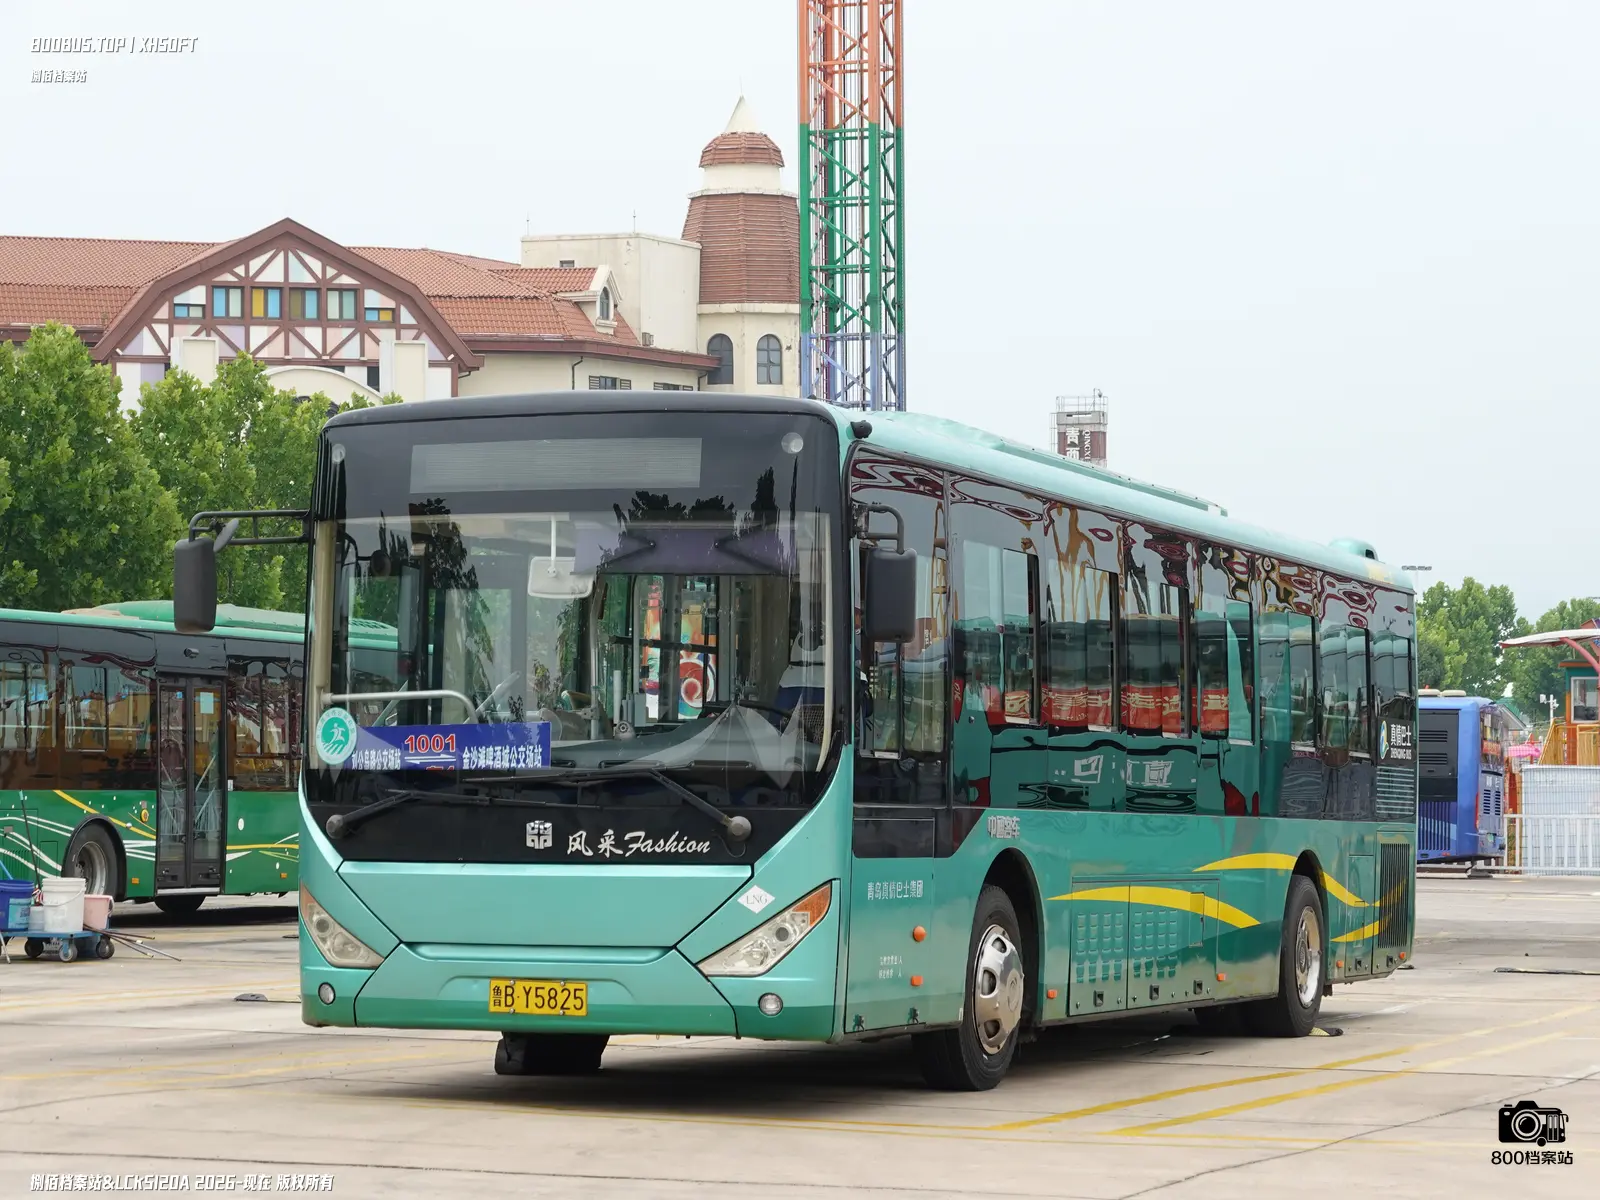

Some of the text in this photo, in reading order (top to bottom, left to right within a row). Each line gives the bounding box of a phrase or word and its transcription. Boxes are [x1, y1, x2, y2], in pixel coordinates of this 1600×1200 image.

[404, 733, 456, 754] 1001
[1390, 724, 1412, 747] 真情巴士
[462, 744, 543, 770] 金沙滩啤酒城公交场站
[567, 829, 711, 858] 风采 Fashion
[745, 893, 768, 905] LNG
[867, 879, 924, 901] 青岛真情巴士集团
